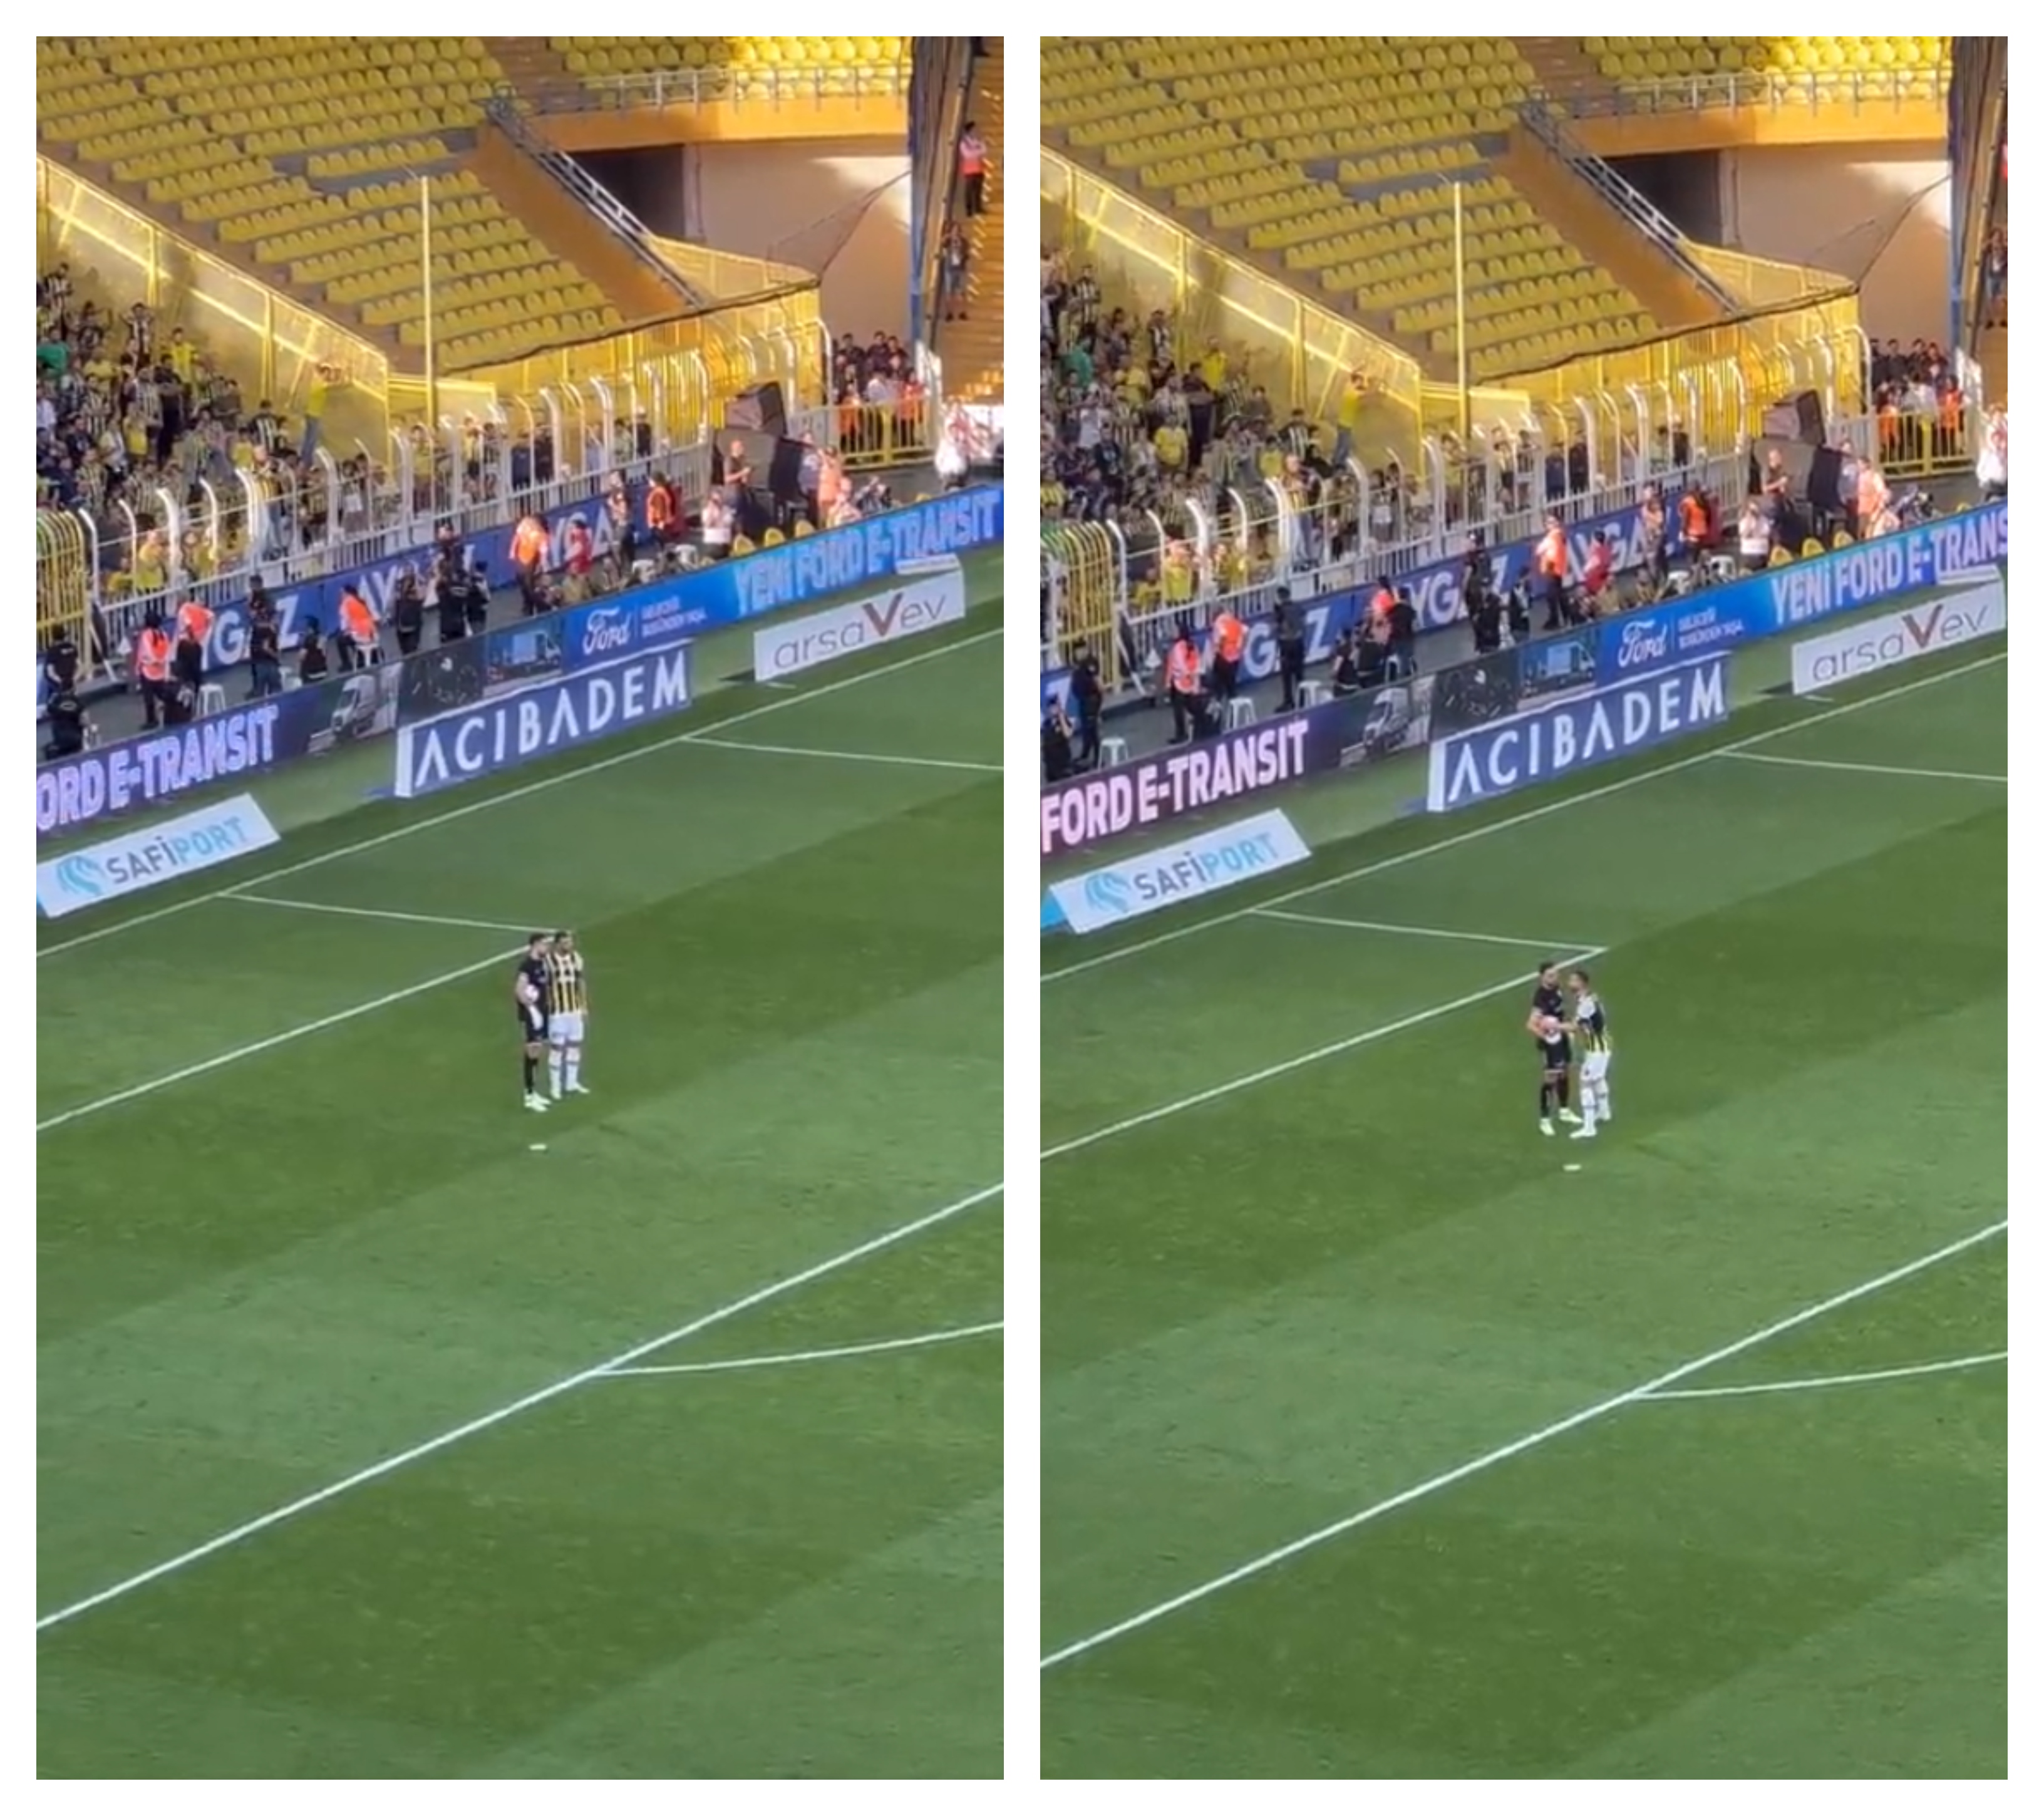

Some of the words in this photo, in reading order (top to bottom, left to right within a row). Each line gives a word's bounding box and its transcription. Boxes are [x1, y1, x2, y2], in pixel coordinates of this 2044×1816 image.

[796, 530, 863, 598] FORD
[1835, 542, 1904, 606] FORD
[582, 606, 631, 654] Ford
[1618, 619, 1668, 668] Ford
[109, 704, 279, 810] E-TRANSIT
[415, 649, 687, 788] ACIBADEM
[1447, 662, 1725, 802] ACIBADEM
[1040, 775, 1132, 854] FORD
[1138, 720, 1308, 822] E-TRANSIT
